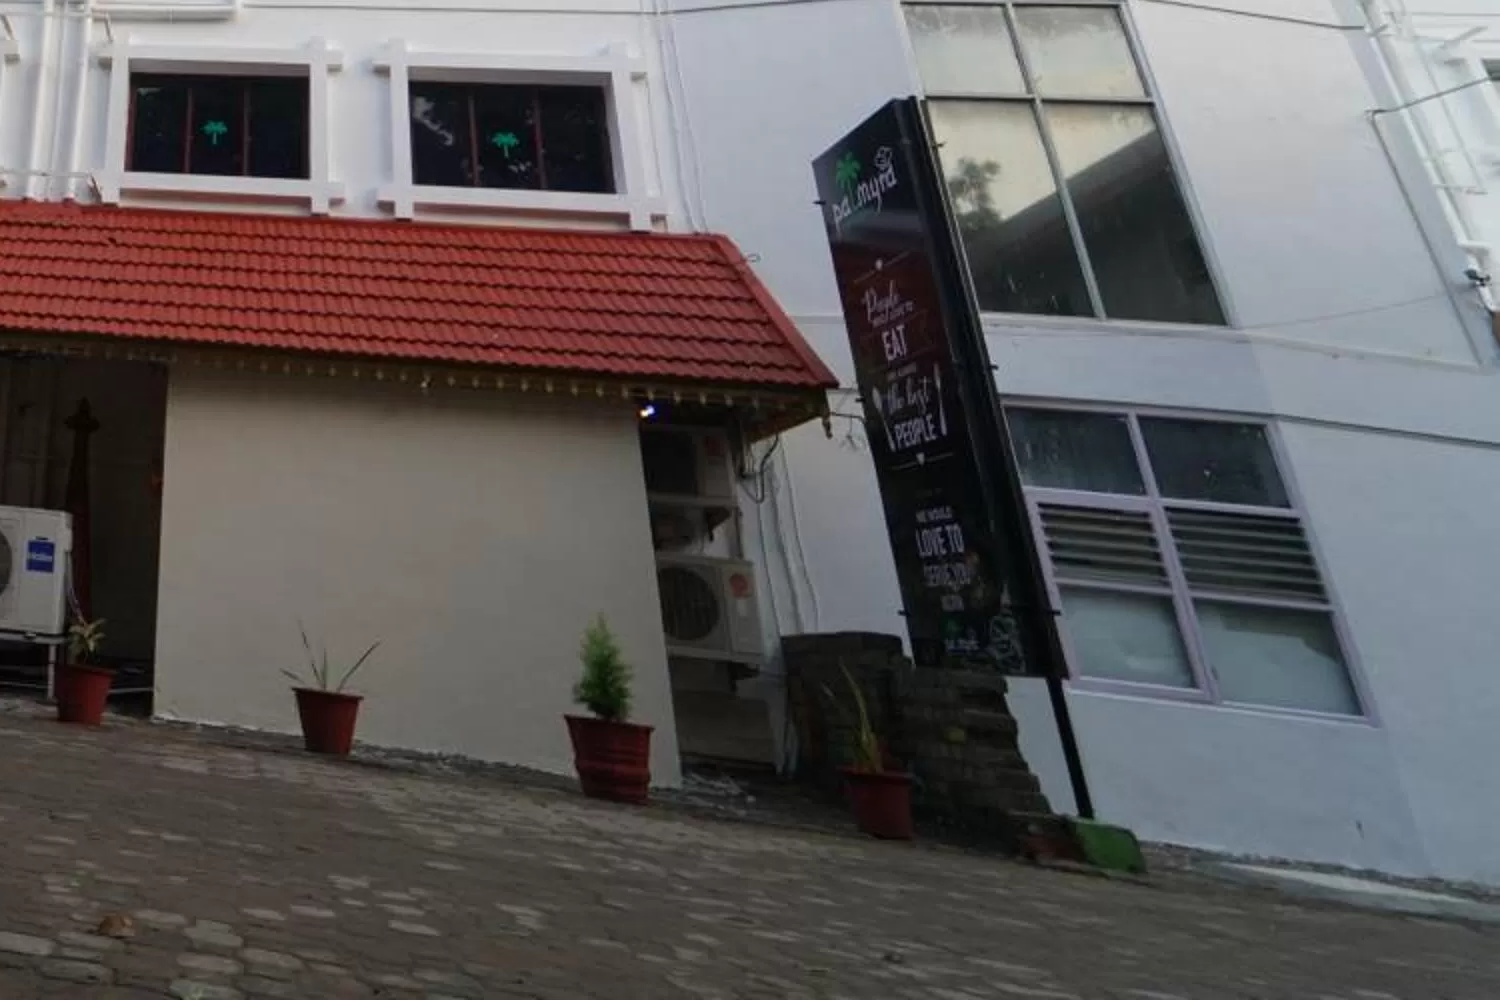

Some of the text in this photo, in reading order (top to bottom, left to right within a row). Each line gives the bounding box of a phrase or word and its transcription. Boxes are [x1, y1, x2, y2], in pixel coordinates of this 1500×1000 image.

[832, 165, 897, 237] palmyra
[881, 324, 908, 361] EAT
[894, 414, 937, 450] PEOPLE
[915, 523, 965, 557] LOVE TO
